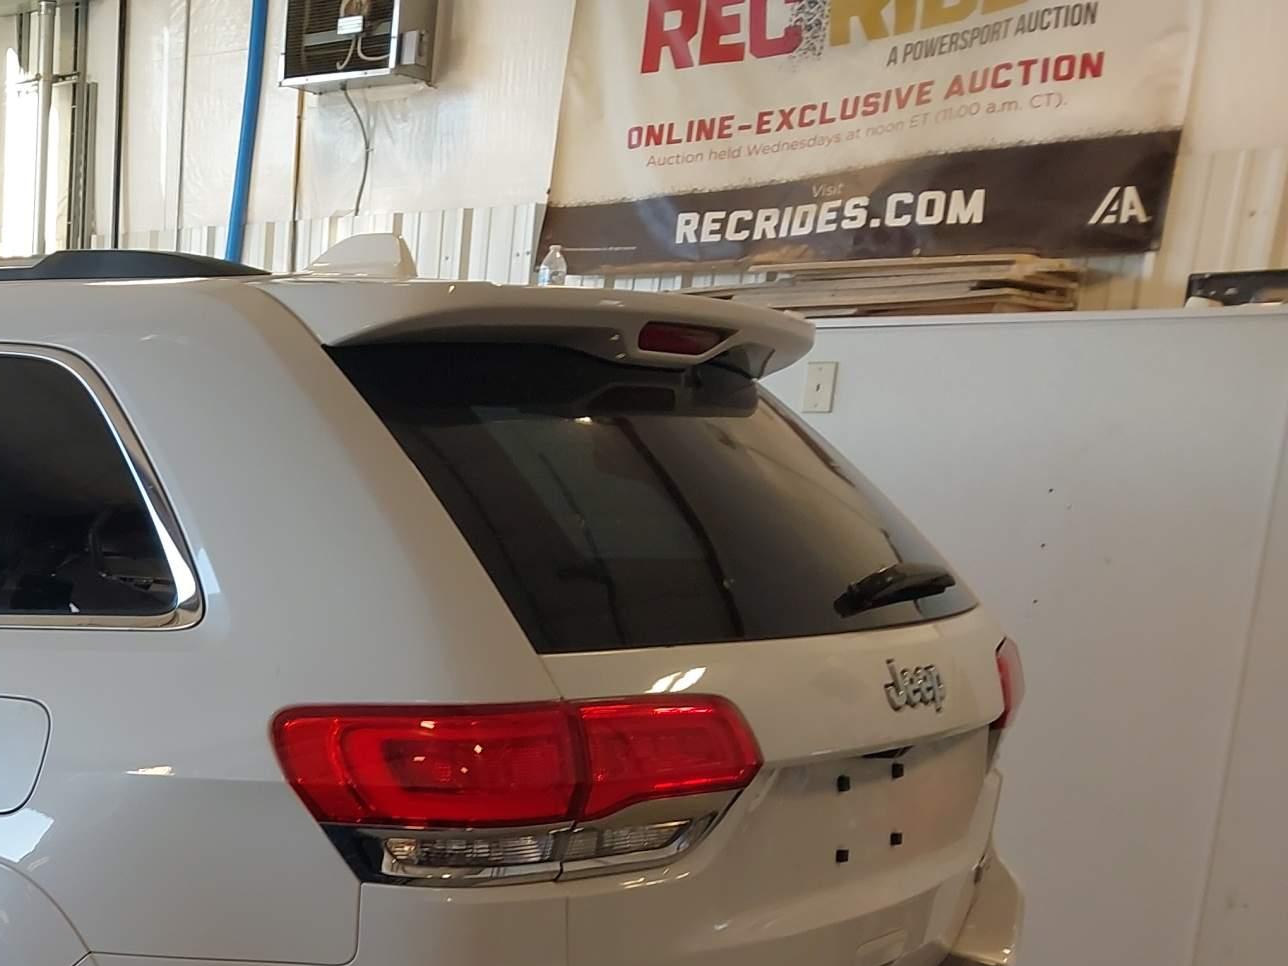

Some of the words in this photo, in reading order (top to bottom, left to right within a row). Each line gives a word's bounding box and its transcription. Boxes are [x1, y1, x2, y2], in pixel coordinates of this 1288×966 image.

[641, 0, 802, 74] REC
[887, 46, 905, 67] A
[902, 18, 1013, 63] POWERSPORT
[1014, 2, 1098, 36] AUCTION
[627, 80, 934, 150] ONLINE-EXCLUSIVE
[944, 51, 1105, 100] AUCTION
[646, 151, 704, 167] Auction
[708, 145, 741, 161] held
[747, 129, 842, 158] Wednesdays
[845, 126, 862, 142] at
[865, 120, 905, 136] noon
[908, 111, 930, 129] ET
[675, 188, 985, 244] RECRIDES.COM
[812, 183, 844, 198] Visit
